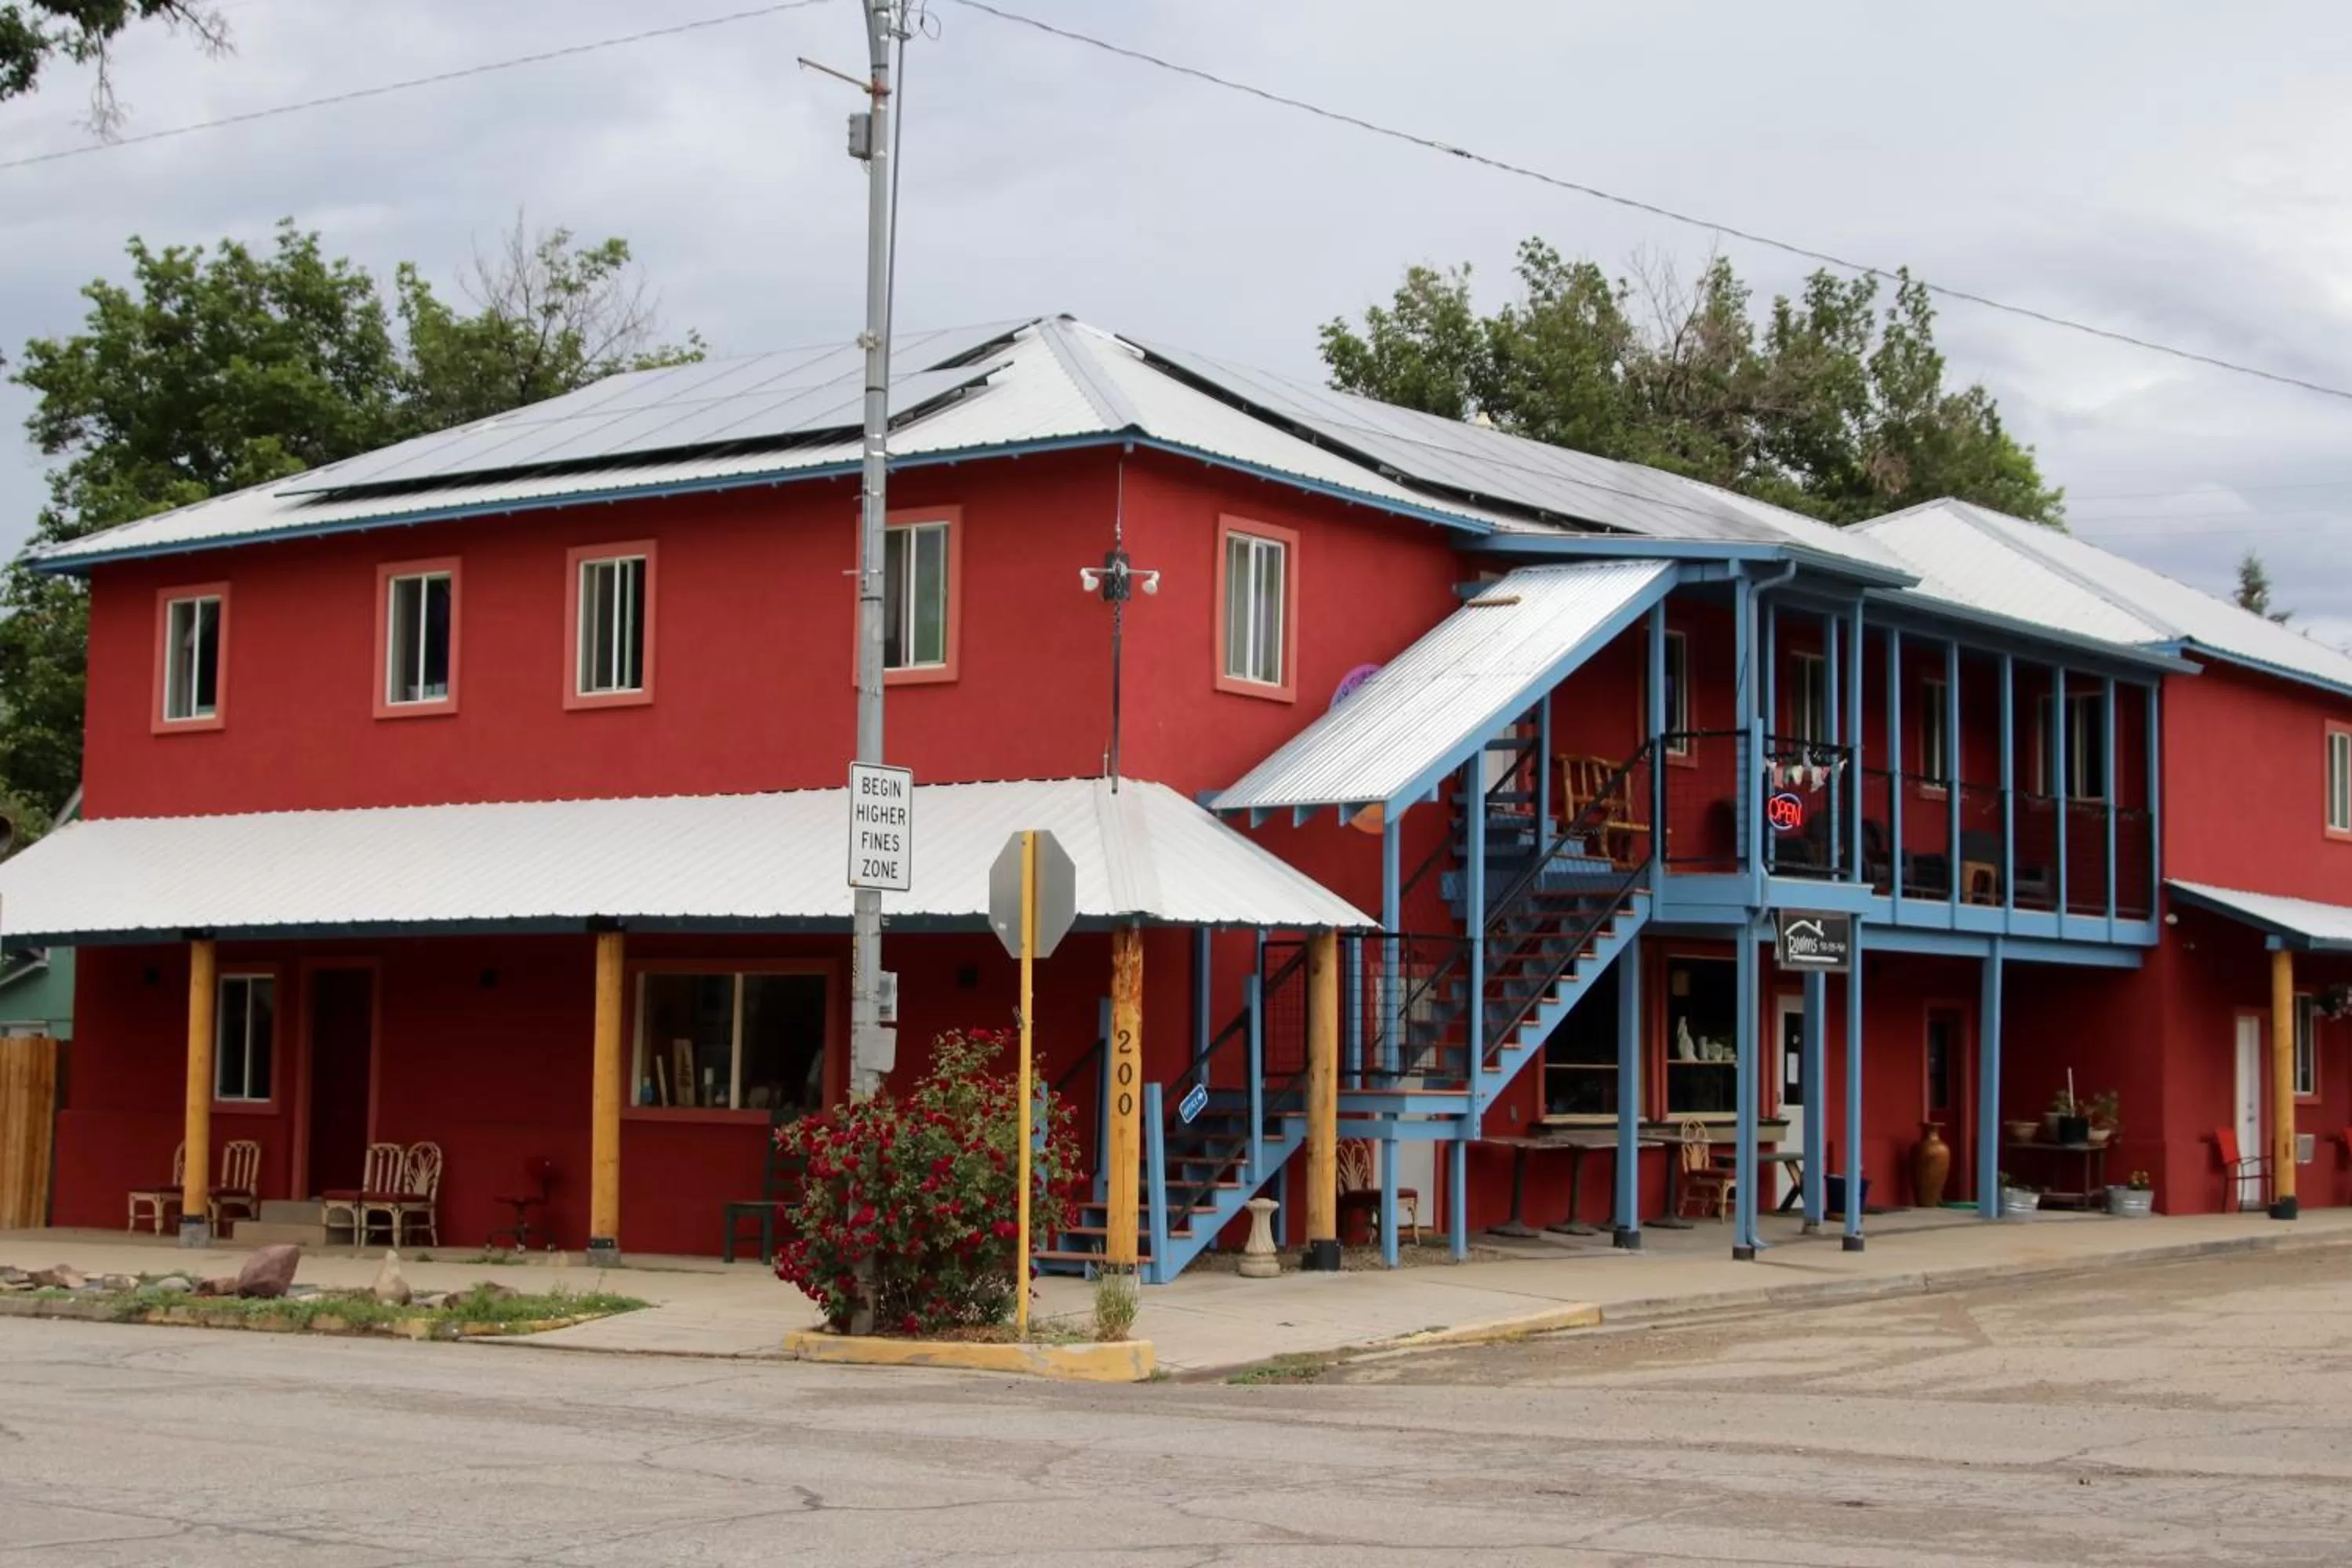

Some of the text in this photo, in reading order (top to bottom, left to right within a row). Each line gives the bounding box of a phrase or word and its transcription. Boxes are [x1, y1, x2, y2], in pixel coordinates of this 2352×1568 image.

[862, 777, 901, 798] BEGIN
[856, 803, 906, 826] HIGHER
[1768, 797, 1801, 827] OPEN
[862, 831, 899, 852] FINES
[862, 858, 898, 879] ZONE
[1117, 1029, 1133, 1116] 200
